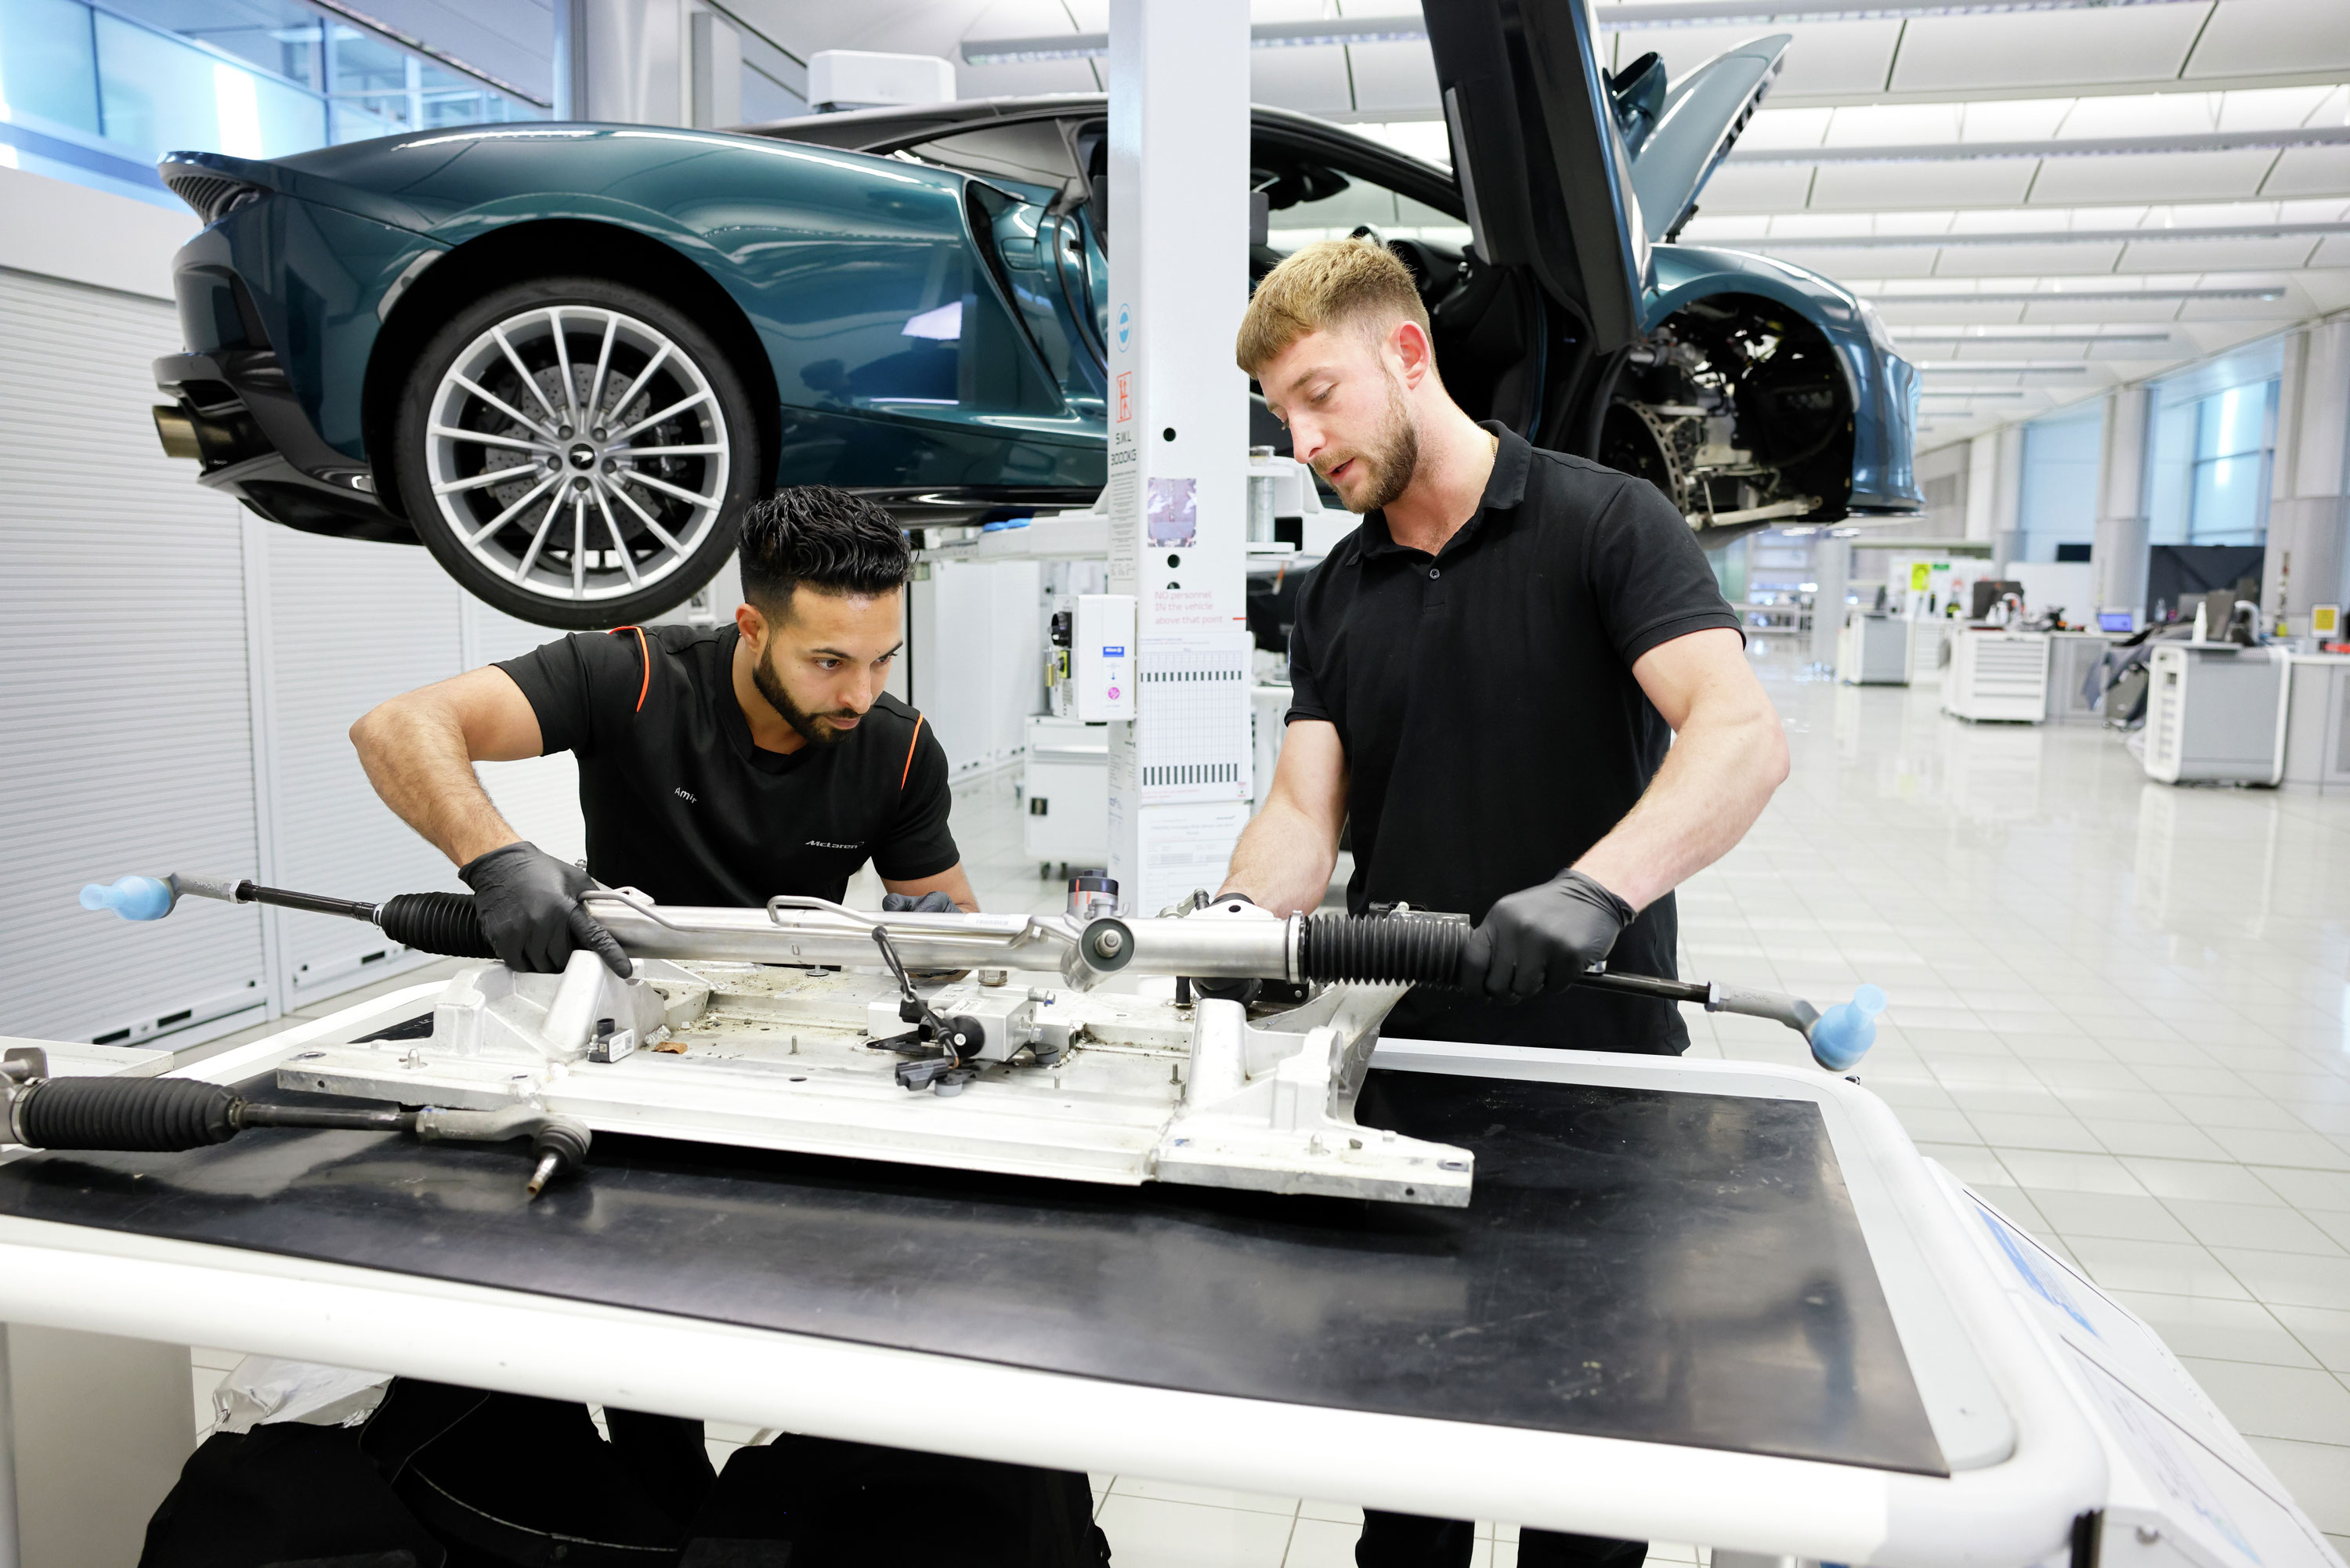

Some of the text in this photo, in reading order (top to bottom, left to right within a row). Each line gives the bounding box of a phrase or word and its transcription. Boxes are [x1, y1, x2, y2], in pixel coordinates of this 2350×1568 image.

[1155, 591, 1212, 601] NO personnel
[1168, 602, 1183, 611] the
[1184, 602, 1213, 611] vehicle
[1155, 615, 1223, 626] above that point
[674, 786, 697, 804] Amir
[804, 840, 859, 849] McLaren
